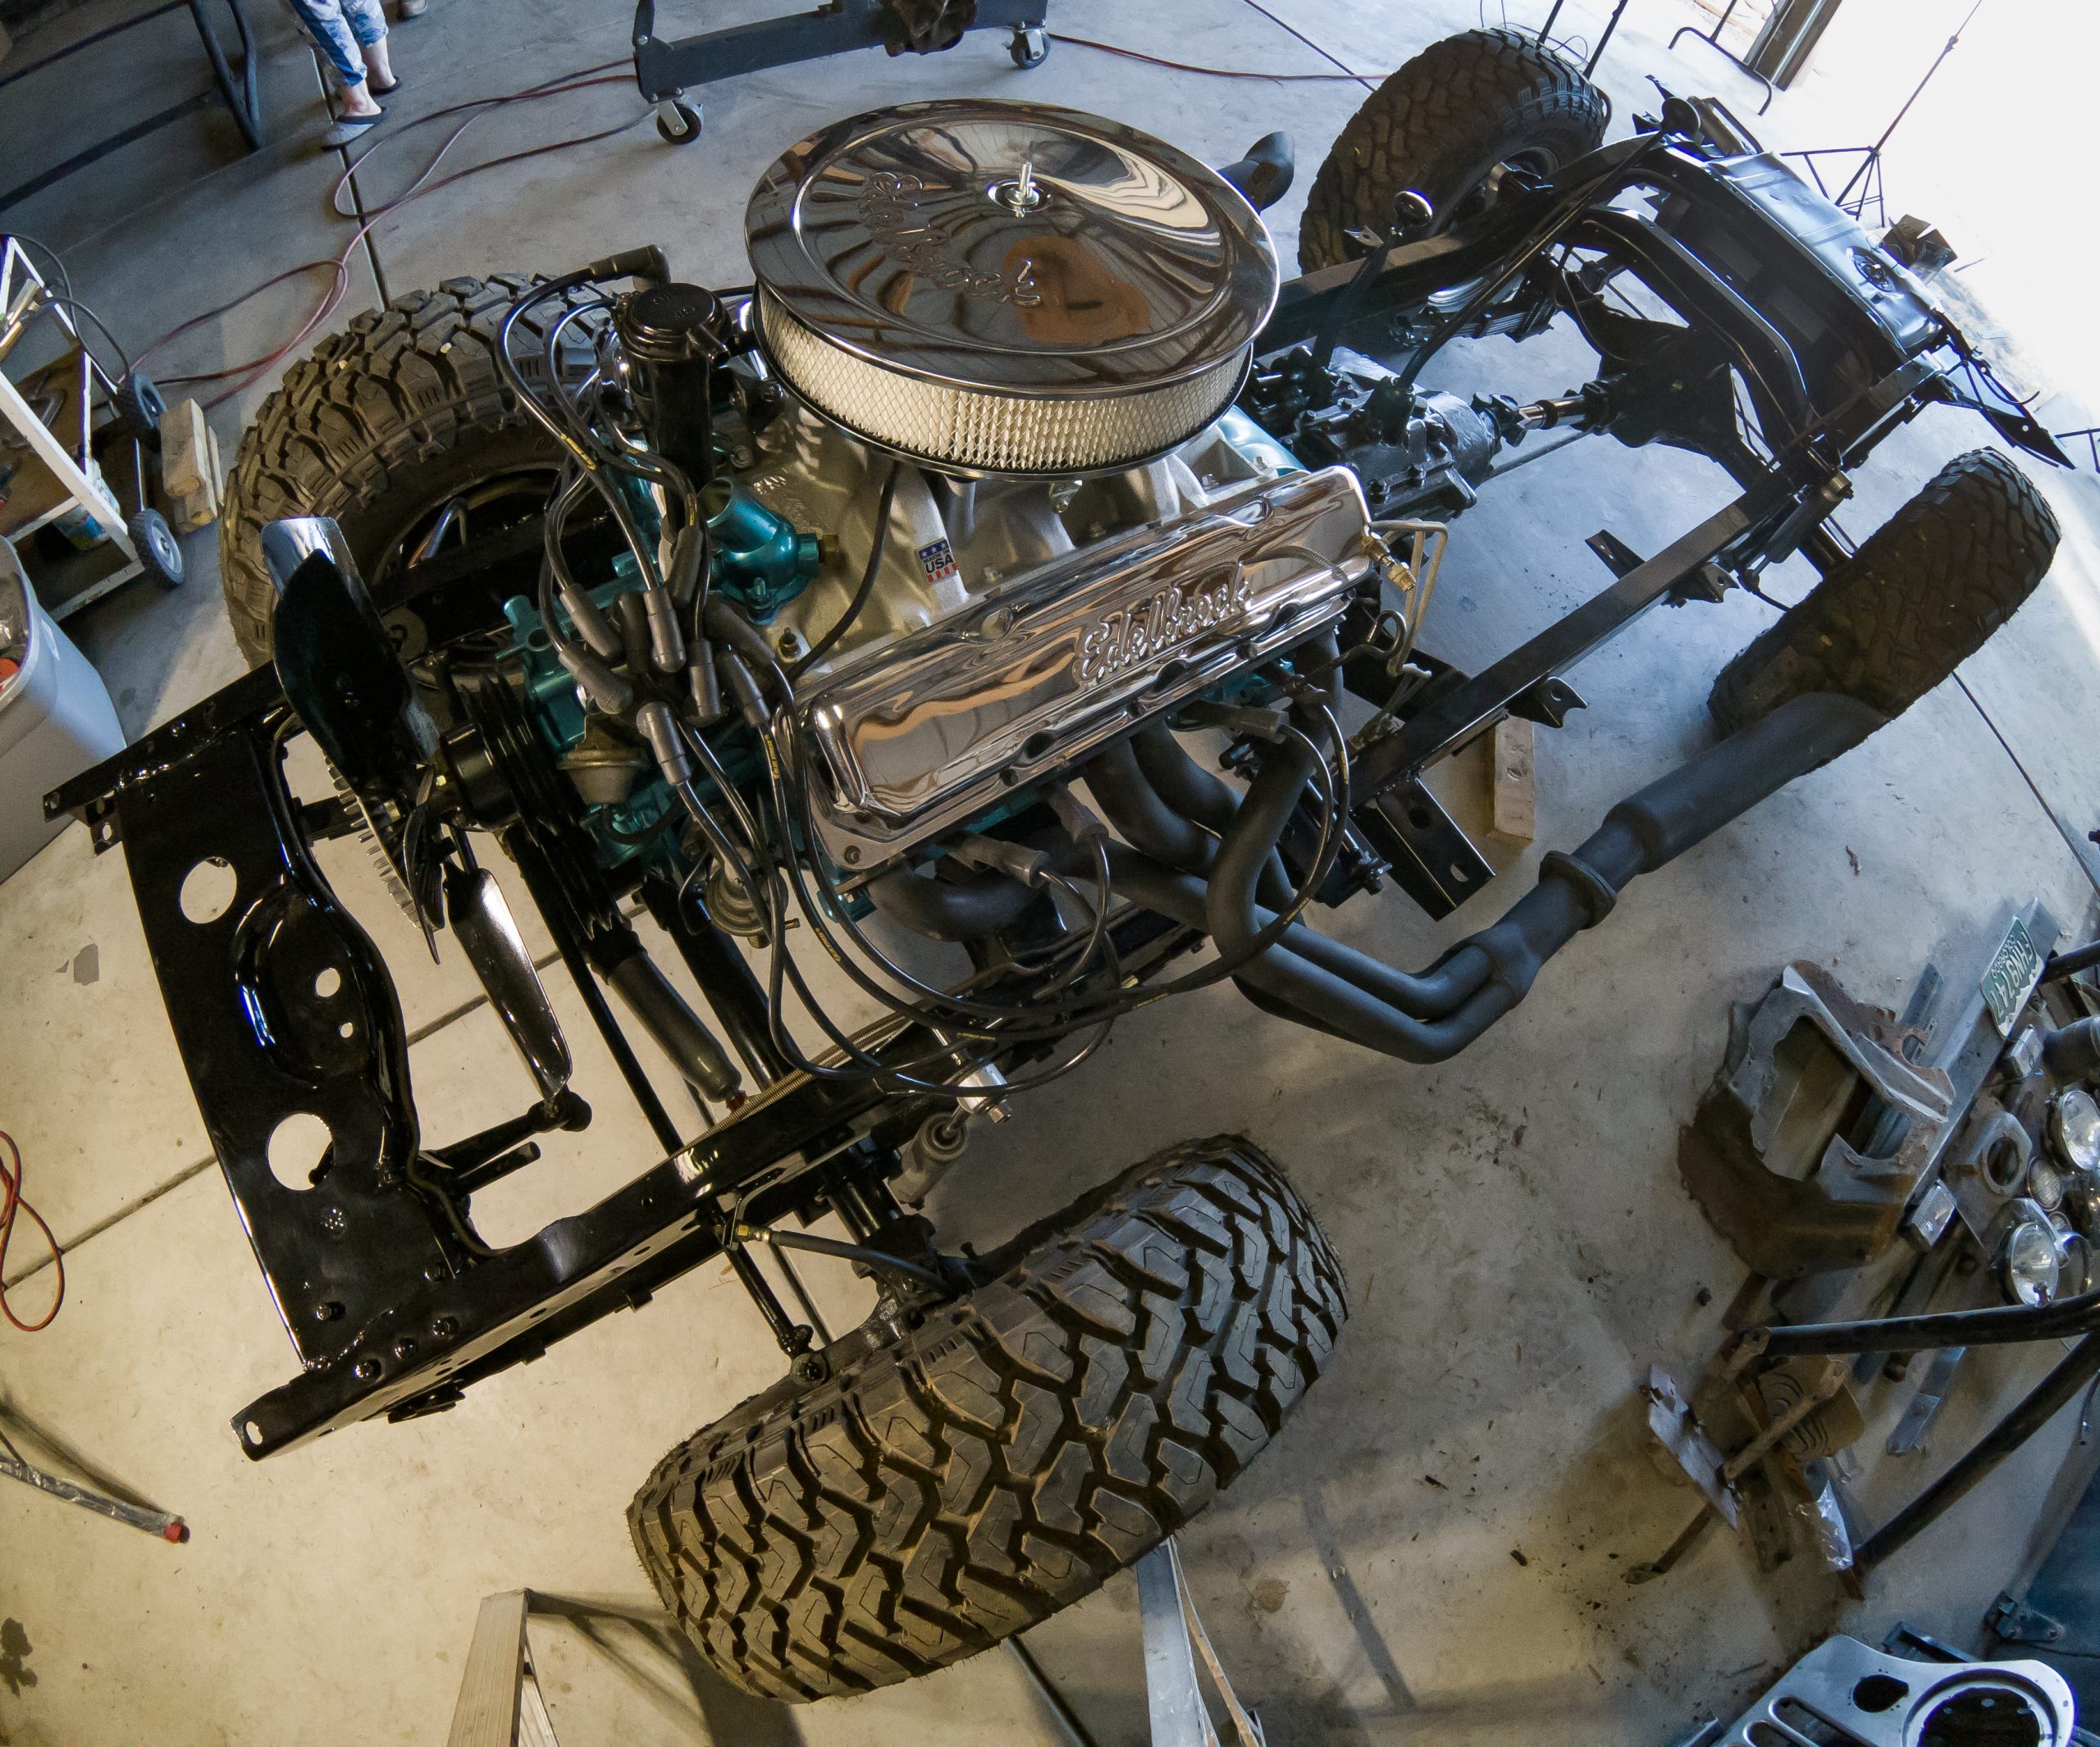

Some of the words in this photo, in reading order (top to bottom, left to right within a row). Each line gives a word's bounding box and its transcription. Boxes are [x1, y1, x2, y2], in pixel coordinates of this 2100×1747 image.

[925, 554, 953, 573] USA
[1079, 564, 1254, 682] Edelbrock
[1991, 934, 2016, 979] COLORADO
